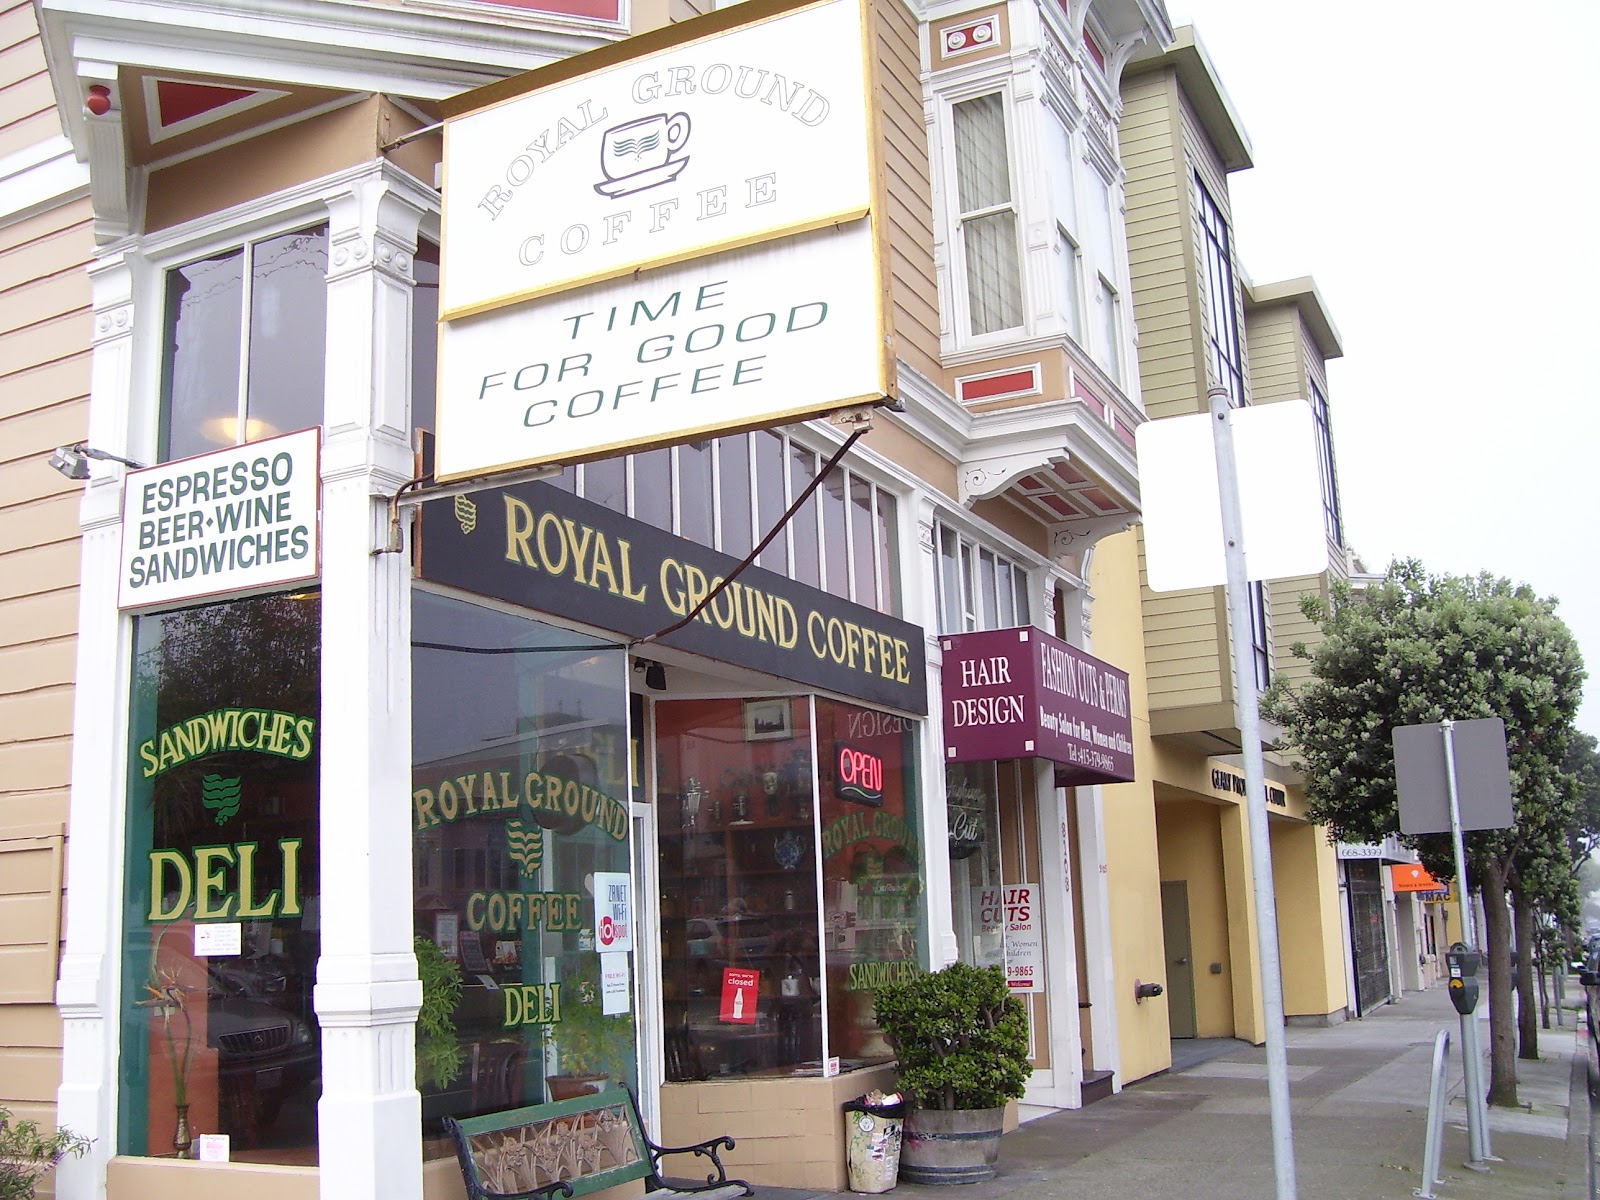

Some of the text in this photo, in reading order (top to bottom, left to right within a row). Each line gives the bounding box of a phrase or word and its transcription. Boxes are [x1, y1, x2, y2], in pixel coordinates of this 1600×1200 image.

[478, 63, 831, 221] ROYAL GROUND
[518, 171, 777, 267] COFFEE
[563, 280, 729, 340] TIME
[478, 301, 828, 400] FOR GOOD
[523, 355, 767, 428] COFFEE
[142, 451, 293, 515] ESPRESSO
[129, 525, 309, 589] SANDWICHES
[503, 493, 911, 685] ROYAL GROUND COFFEE
[960, 656, 1012, 688] HAIR
[1041, 642, 1127, 718] FASHION CUTS & PERMS
[952, 694, 1025, 727] DESIGN
[1040, 705, 1058, 737] Beauty
[1059, 712, 1073, 737] Salon
[140, 710, 314, 778] SANDWICHES
[840, 748, 882, 791] OPEN
[413, 771, 629, 842] ROYAL GROUND
[1341, 848, 1382, 857] 668-3399
[148, 839, 302, 921] DELI
[981, 889, 1030, 905] HAIR
[466, 892, 583, 931] COFFEE
[1010, 922, 1031, 931] Salon
[850, 961, 917, 990] SANDWICHES
[1006, 948, 1031, 957] hildren
[503, 983, 562, 1027] DELI
[728, 978, 754, 987] closed
